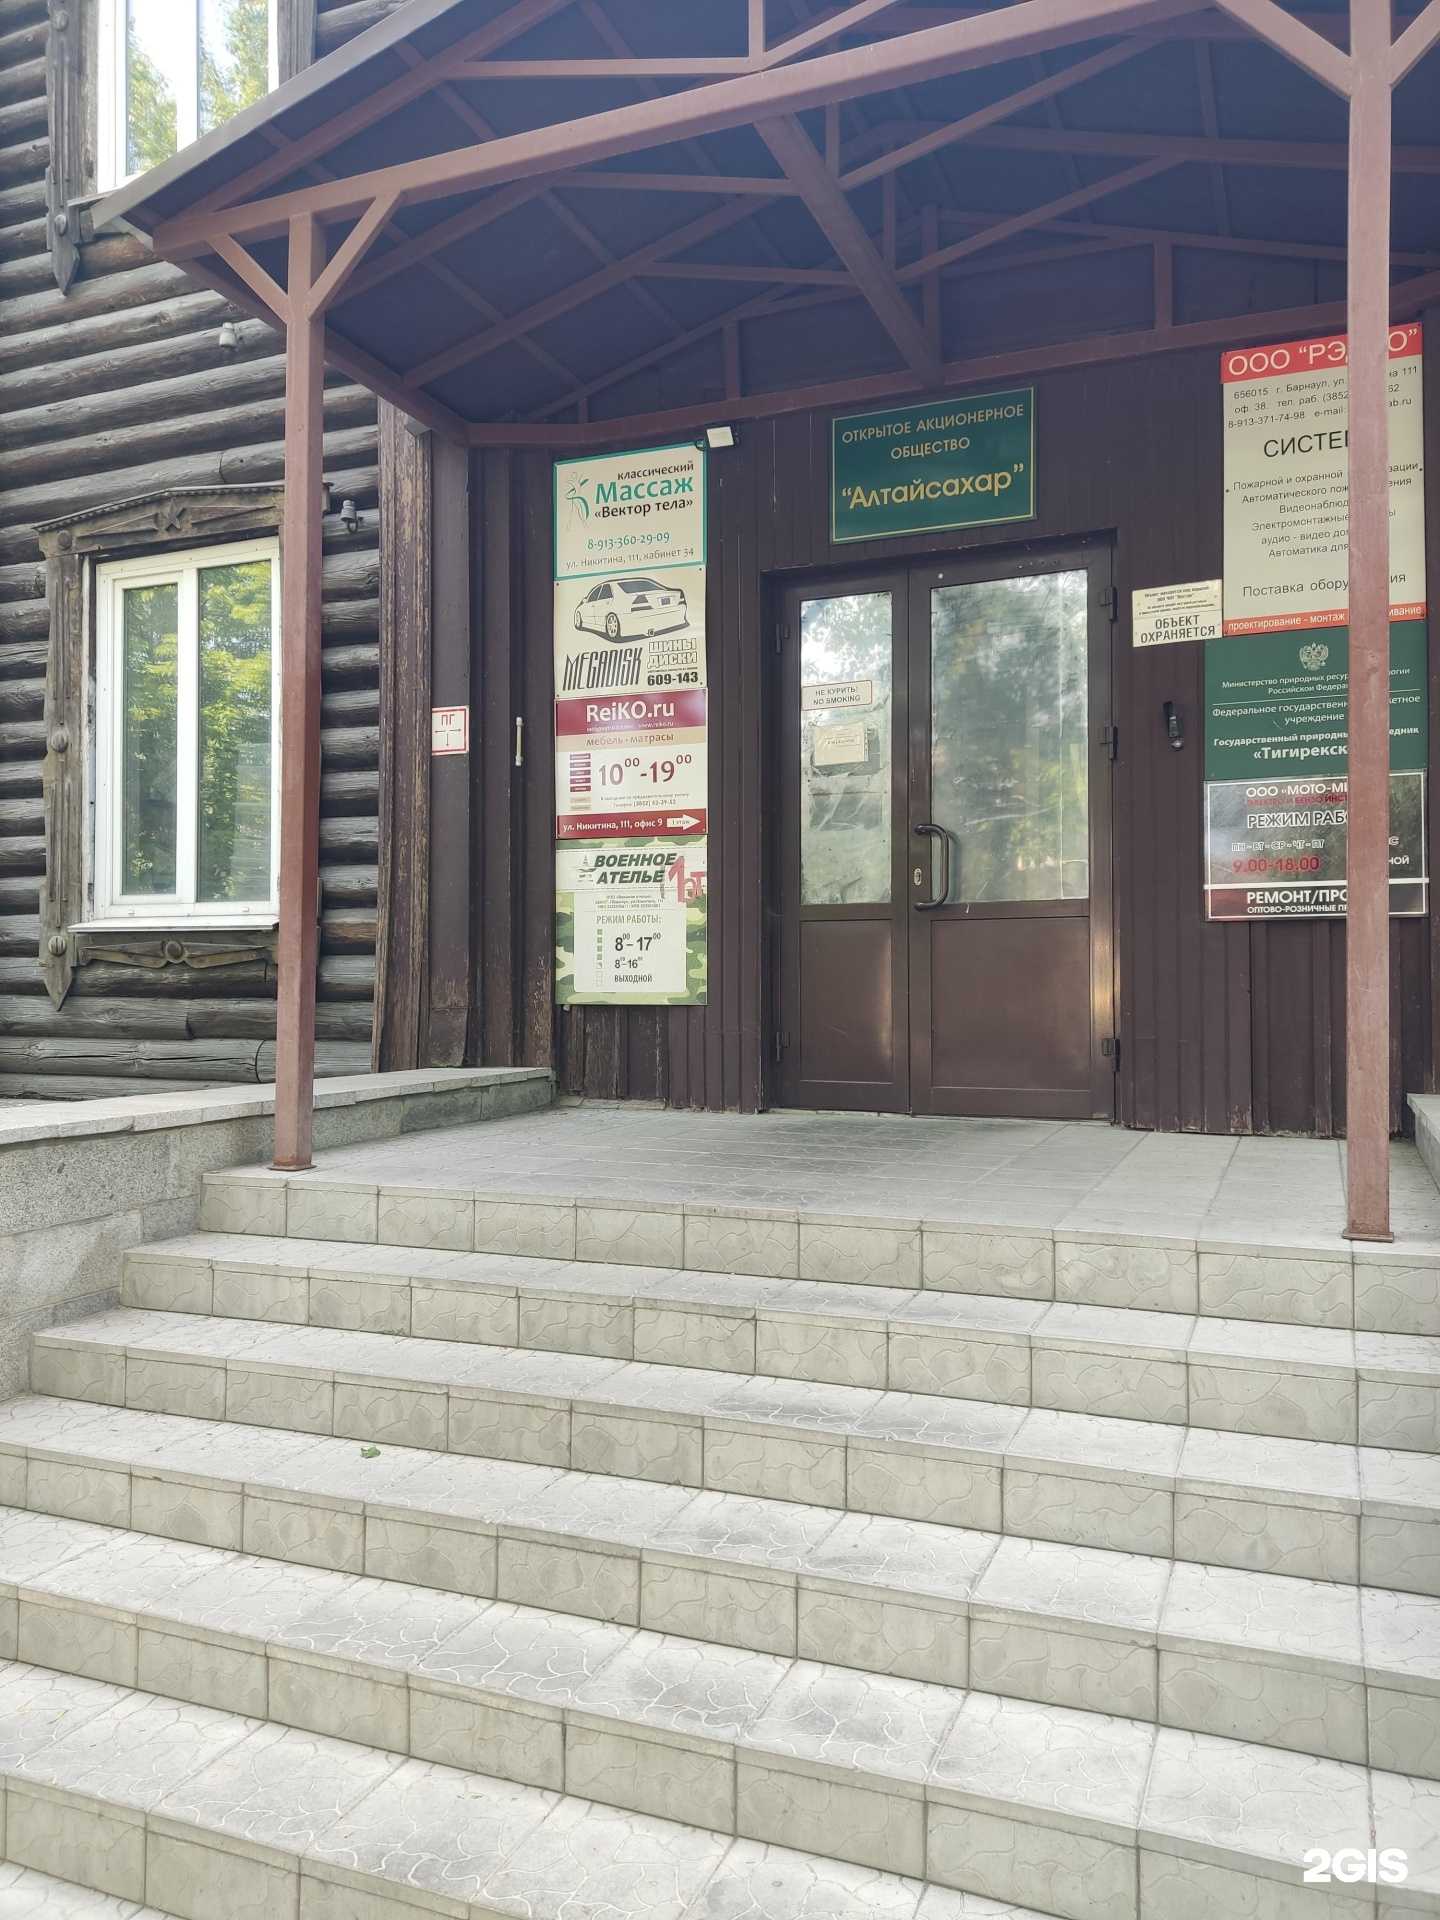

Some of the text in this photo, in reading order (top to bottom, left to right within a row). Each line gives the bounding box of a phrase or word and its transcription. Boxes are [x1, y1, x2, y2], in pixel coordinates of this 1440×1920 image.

[1228, 349, 1290, 375] ООО
[1233, 387, 1269, 400] 656015
[842, 404, 1024, 443] ОТКРЫТОЕ АКЦИОНЕРНОЕ
[1228, 411, 1305, 428] 8-913-371-74-98
[890, 436, 971, 459] ОБЩЕСТВО
[1264, 430, 1349, 458] СИСТЕ
[617, 460, 694, 480] классический
[1233, 476, 1283, 491] Пожарной
[1295, 469, 1343, 483] охранной
[595, 476, 694, 504] Массаж
[1241, 487, 1327, 504] Автоматического
[594, 499, 694, 518] «Вектор тела»
[1279, 499, 1349, 514] Видеонаблюд
[1251, 513, 1351, 532] Электромонтажные
[587, 532, 670, 550] 8-913-360-29-09
[1261, 535, 1290, 546] аудио
[1300, 531, 1331, 542] видео
[581, 556, 626, 567] Никитина,
[643, 549, 681, 560] кабинет
[1268, 545, 1328, 558] Автоматика
[1242, 580, 1304, 598] Поставка
[1155, 615, 1200, 630] ОБЪЕКТ
[1228, 614, 1302, 631] проектирование
[1309, 613, 1345, 624] монтаж
[1140, 626, 1216, 643] ОХРАНЯЕТСЯ
[648, 638, 697, 653] ШИНЫ
[647, 652, 698, 669] ДИСКИ
[562, 647, 643, 691] MEGADISK
[647, 671, 699, 686] 609-143
[1222, 678, 1278, 689] Министерство
[1279, 675, 1325, 684] природных
[1326, 673, 1348, 681] ресур
[1268, 683, 1348, 695] Российской Федера
[826, 695, 861, 704] SMOKING
[586, 700, 675, 722] ReiKO.ru
[1212, 706, 1277, 717] Федеральное
[1284, 713, 1345, 725] учреждение
[441, 714, 456, 726] ПГ
[586, 734, 674, 747] мебель матрасы
[1213, 733, 1298, 747] Государственный
[1300, 731, 1348, 743] природны
[1253, 745, 1349, 760] «Тигирекск
[1246, 786, 1279, 798] ООО
[562, 823, 574, 832] ул.
[576, 820, 619, 831] Никитина,
[634, 818, 656, 830] офис
[657, 818, 663, 826] 9
[1247, 810, 1348, 829] РЕЖИМ РАБ
[594, 853, 678, 868] ВОЕННОЕ
[1232, 855, 1321, 873] 9.00-18.00
[596, 870, 665, 885] АТЕЛЬЕ
[1247, 904, 1337, 914] ОПТОВО-РОЗНИЧНЫЕ
[596, 913, 662, 925] РЕЖИМ РАБОТЫ:
[614, 974, 653, 984] ВЫХОДНОЙ
